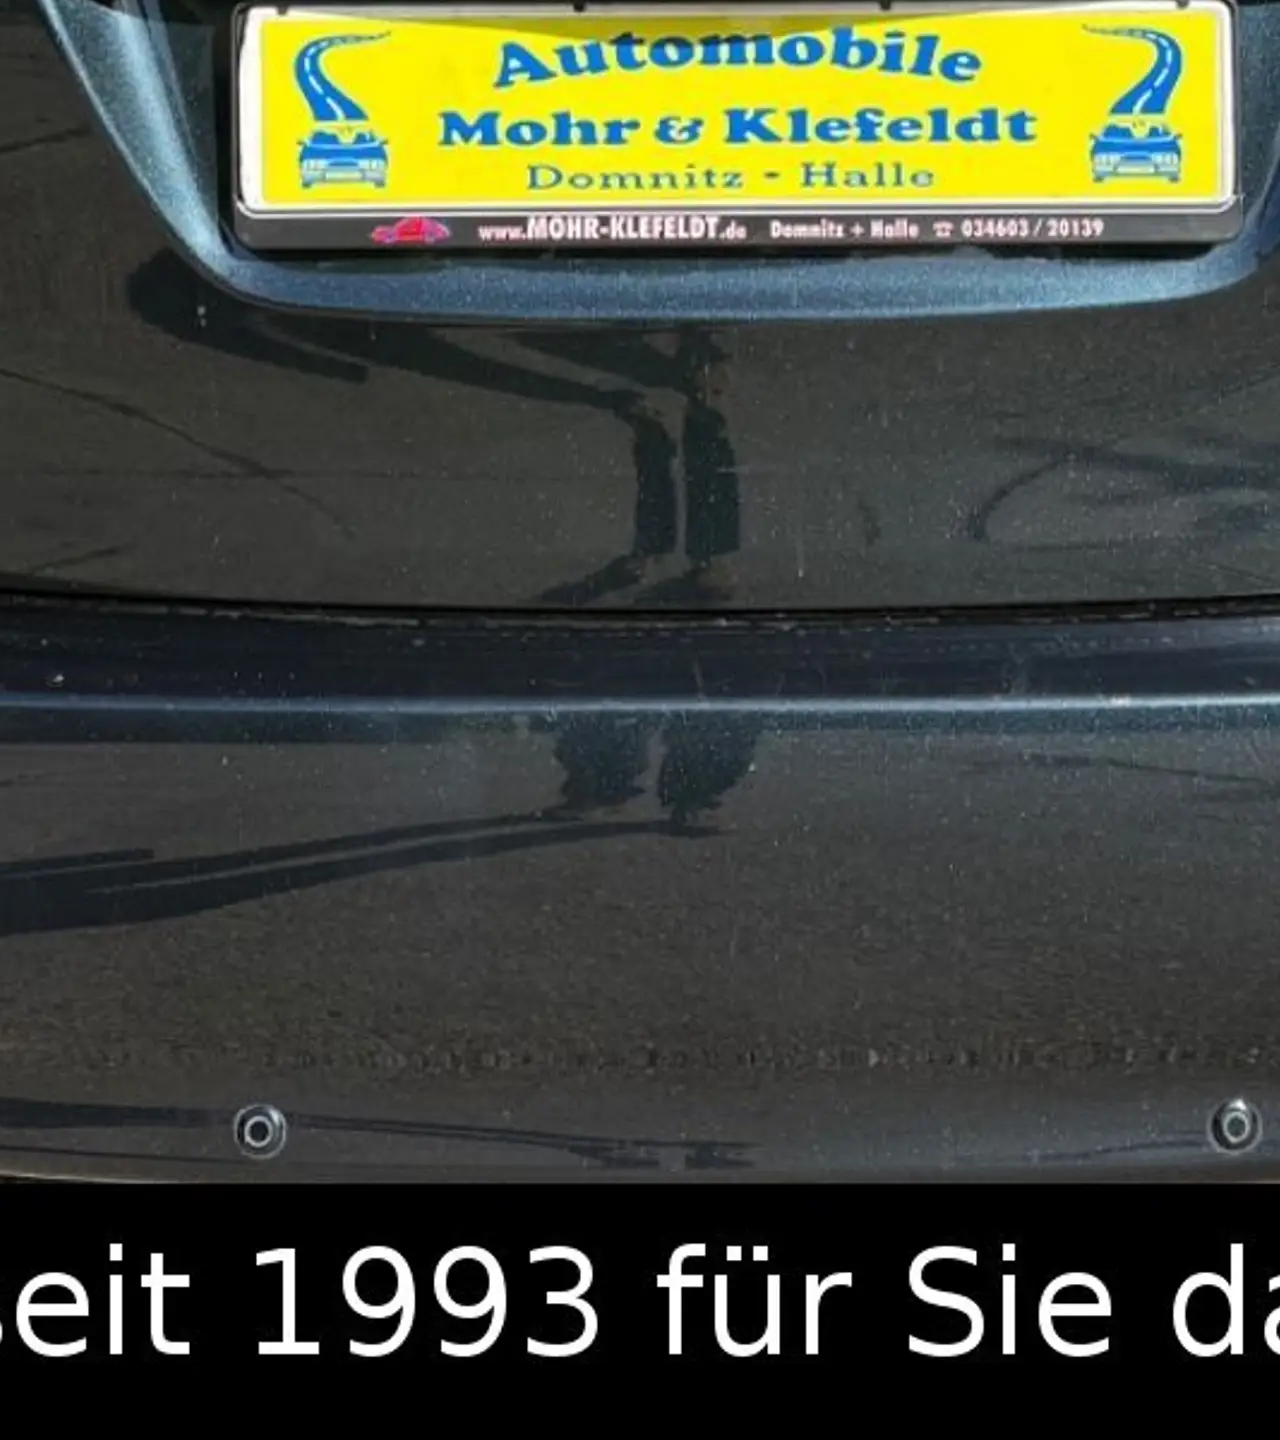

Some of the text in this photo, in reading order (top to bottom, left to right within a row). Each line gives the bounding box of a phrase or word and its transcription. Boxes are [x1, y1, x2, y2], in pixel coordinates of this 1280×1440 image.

[493, 26, 982, 88] Automobile
[438, 108, 1038, 146] Mohr & Klefeldt
[527, 163, 744, 190] Domnitz
[800, 162, 935, 188] Halle
[478, 215, 748, 241] www.MOHR-KLEFELDT.de
[870, 218, 920, 239] Halle
[1046, 217, 1105, 239] 20139
